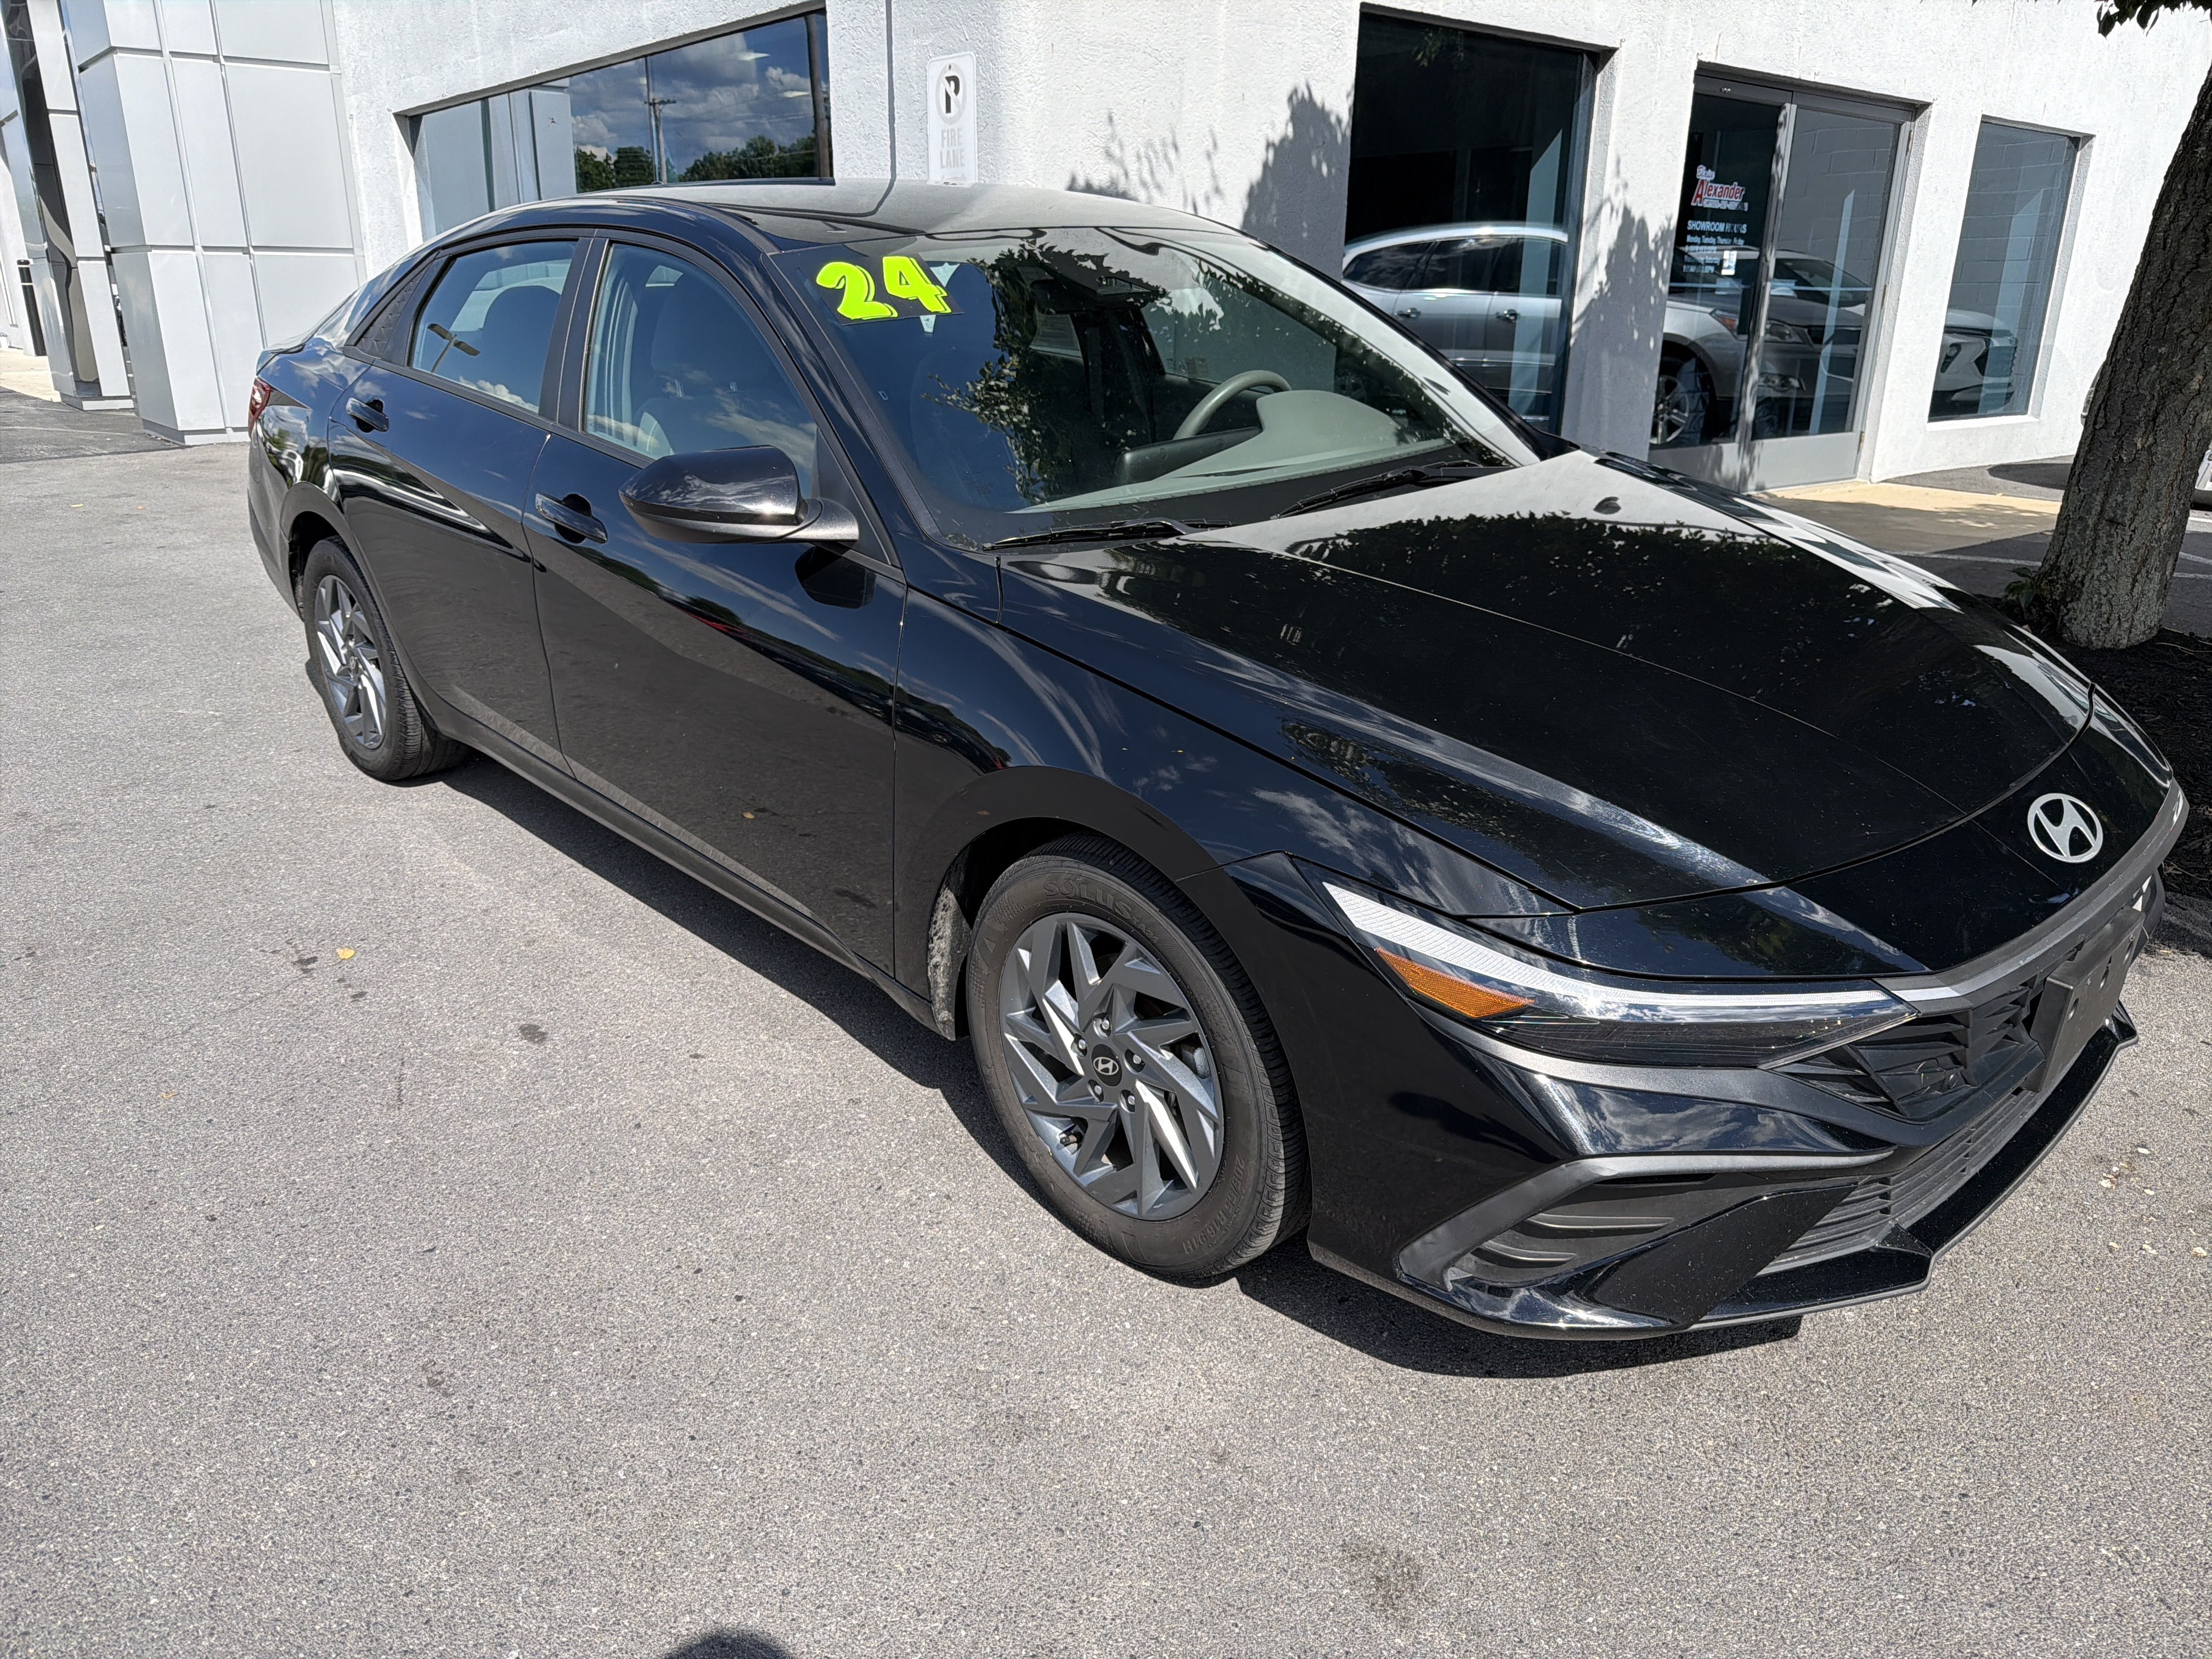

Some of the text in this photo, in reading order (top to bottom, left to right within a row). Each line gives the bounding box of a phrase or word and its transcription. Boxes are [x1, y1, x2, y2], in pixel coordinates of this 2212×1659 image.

[941, 128, 963, 148] FIRE
[940, 149, 965, 169] LANE
[1692, 178, 1745, 205] Alexander
[1687, 220, 1725, 232] SHOWROOM
[816, 256, 952, 320] 24
[1043, 879, 1132, 920] SOLUS
[1224, 1153, 1246, 1211] 205/55
